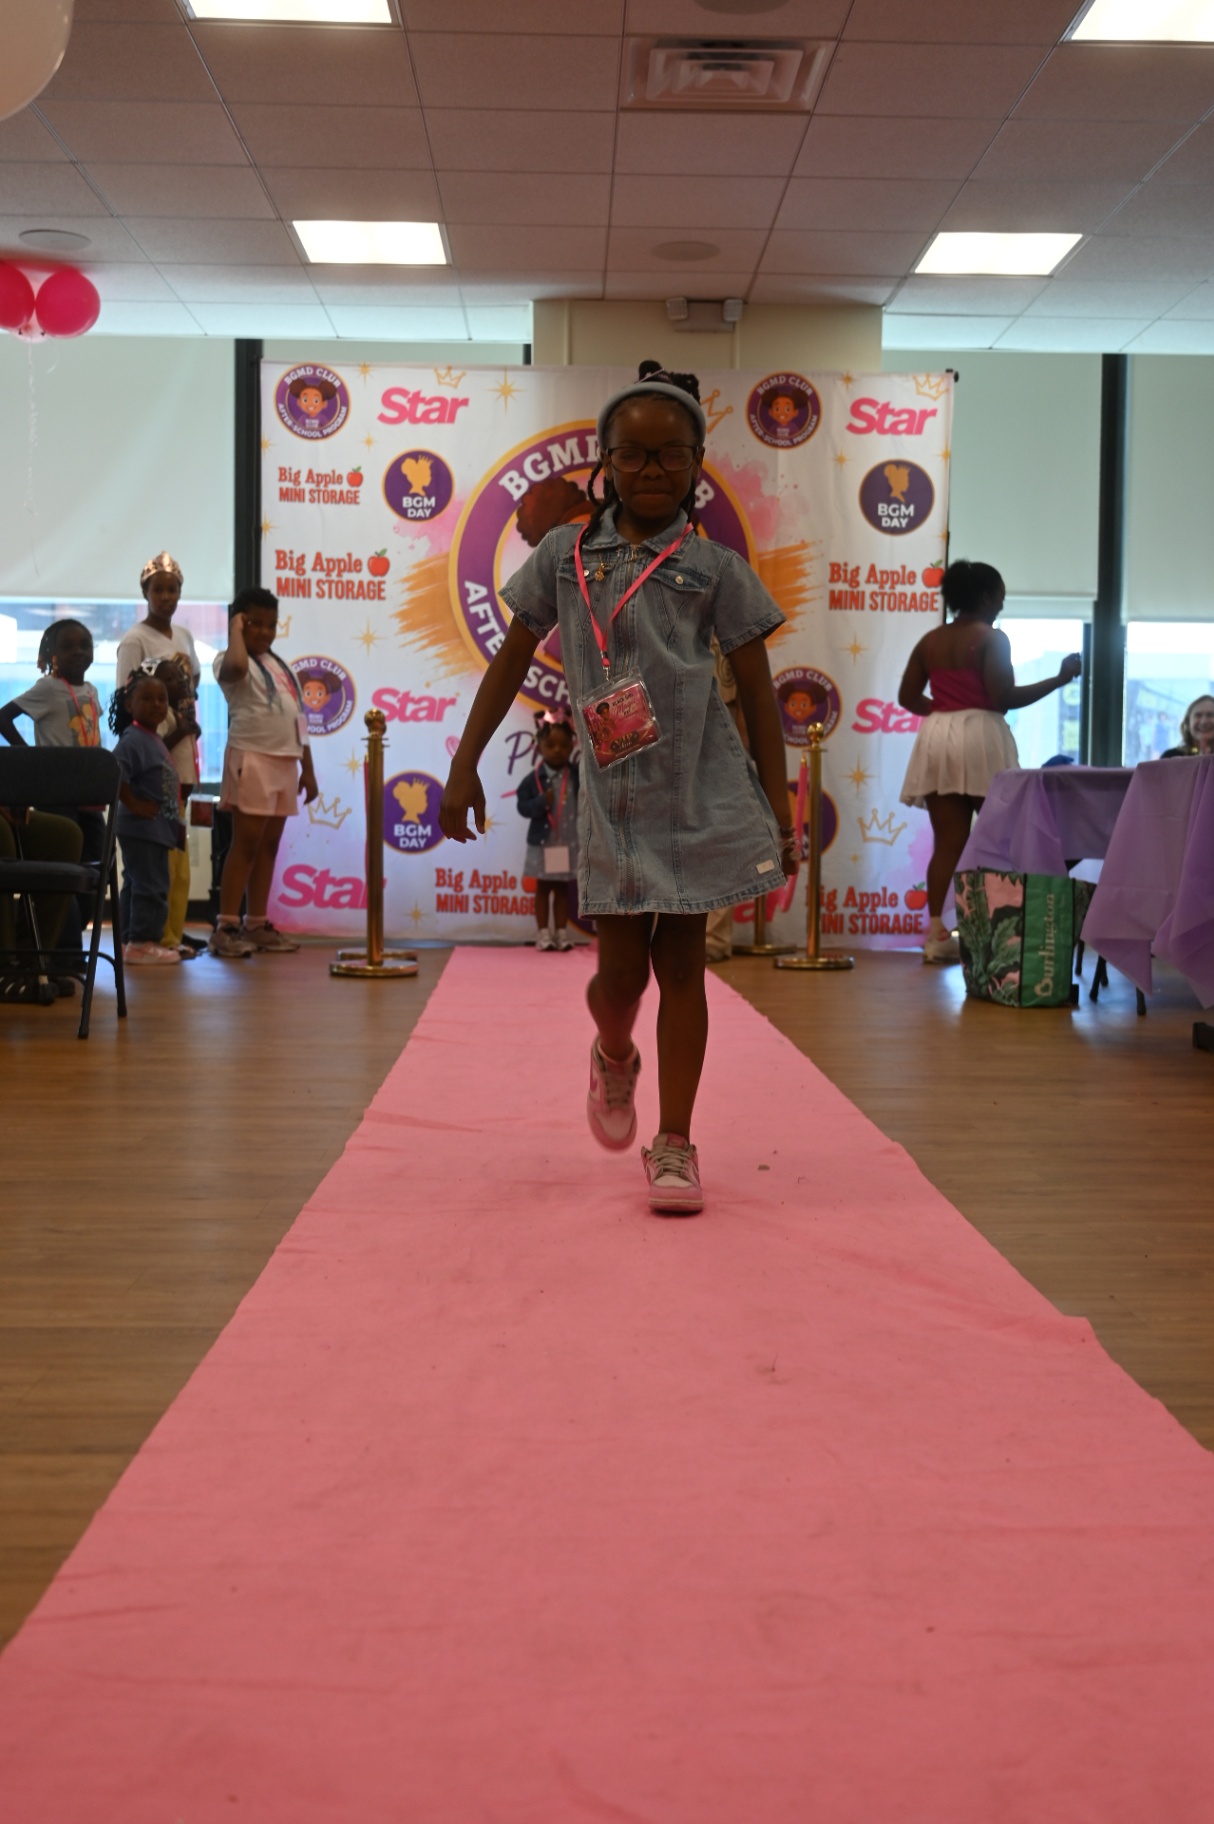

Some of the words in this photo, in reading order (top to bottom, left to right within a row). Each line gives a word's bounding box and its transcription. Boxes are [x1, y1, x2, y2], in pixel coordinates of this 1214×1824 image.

[284, 366, 314, 385] BGMD
[316, 368, 341, 387] CLUB
[757, 375, 786, 395] BGMD
[788, 376, 813, 396] CLUB
[377, 386, 469, 425] Star
[846, 397, 938, 435] Star
[278, 466, 301, 486] Big
[305, 468, 343, 487] Apple
[279, 487, 305, 502] MINI
[308, 488, 360, 505] STORAGE
[402, 496, 436, 508] BGM
[407, 508, 432, 518] DAY
[877, 504, 915, 516] BGM
[881, 517, 909, 528] DAY
[275, 550, 307, 576] Big
[312, 552, 362, 577] Apple
[829, 563, 860, 586] Big
[865, 564, 916, 589] Apple
[276, 577, 312, 598] MINI
[316, 579, 386, 600] STORAGE
[828, 590, 866, 610] MINI
[869, 592, 939, 612] STORAGE
[292, 658, 318, 673] GMD
[320, 660, 347, 681] CLUB
[806, 671, 833, 691] CLUB
[371, 687, 457, 723] Star
[851, 697, 926, 734] Sta
[393, 824, 432, 837] BGM
[399, 837, 426, 849] DAY
[435, 868, 464, 893] Big
[469, 869, 517, 894] Apple
[436, 893, 469, 913] MINI
[844, 886, 898, 912] Apple
[808, 913, 844, 934] INI
[848, 914, 924, 935] STORAGE
[1034, 893, 1057, 996] Burlington
